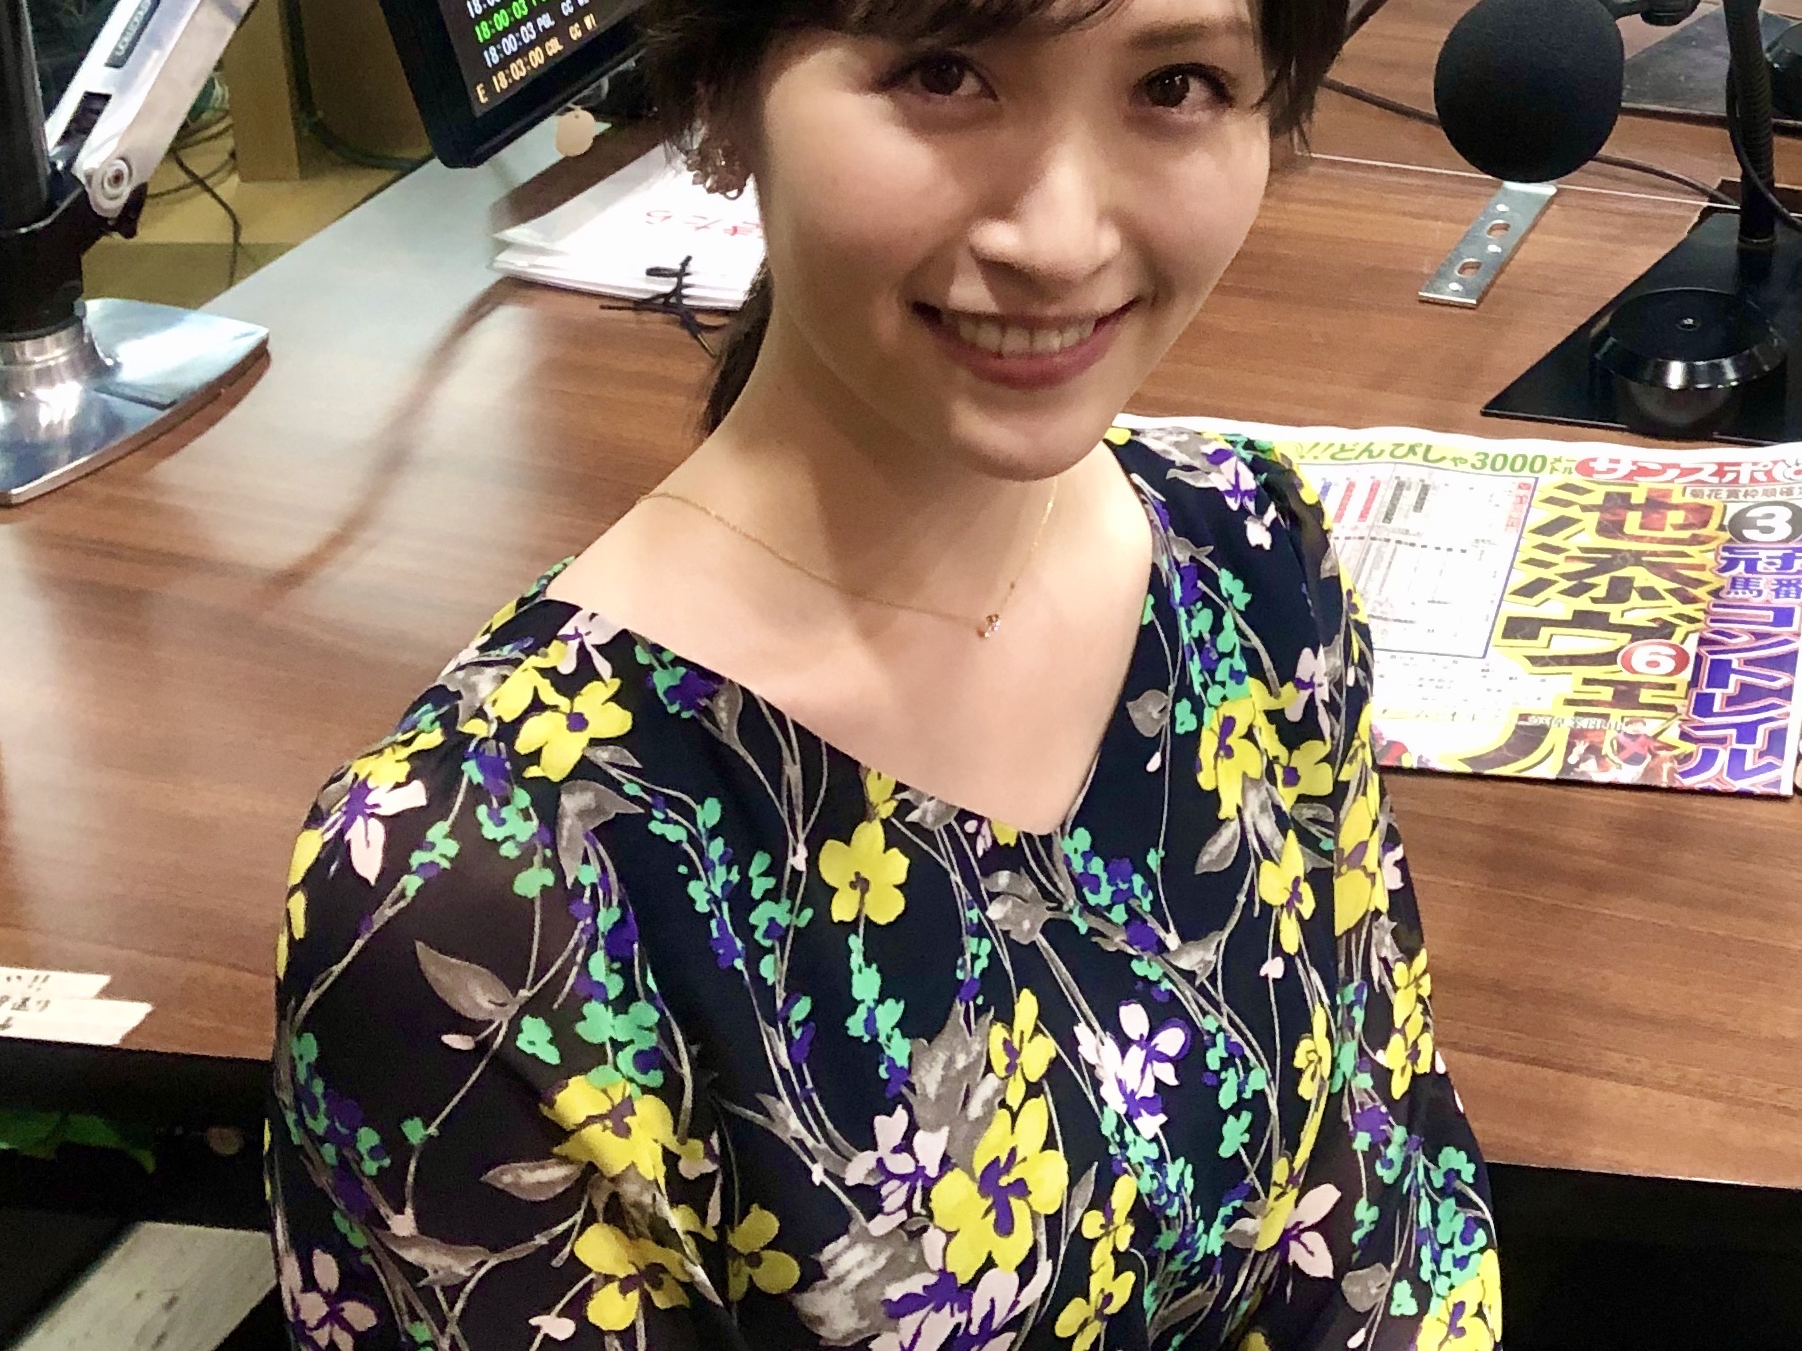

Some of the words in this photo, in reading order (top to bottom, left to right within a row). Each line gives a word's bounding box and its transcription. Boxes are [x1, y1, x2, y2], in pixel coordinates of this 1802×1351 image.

[484, 22, 536, 67] 18:00:03
[476, 84, 488, 103] E
[493, 46, 544, 92] 18:03:00
[1588, 456, 1770, 485] サンスポ
